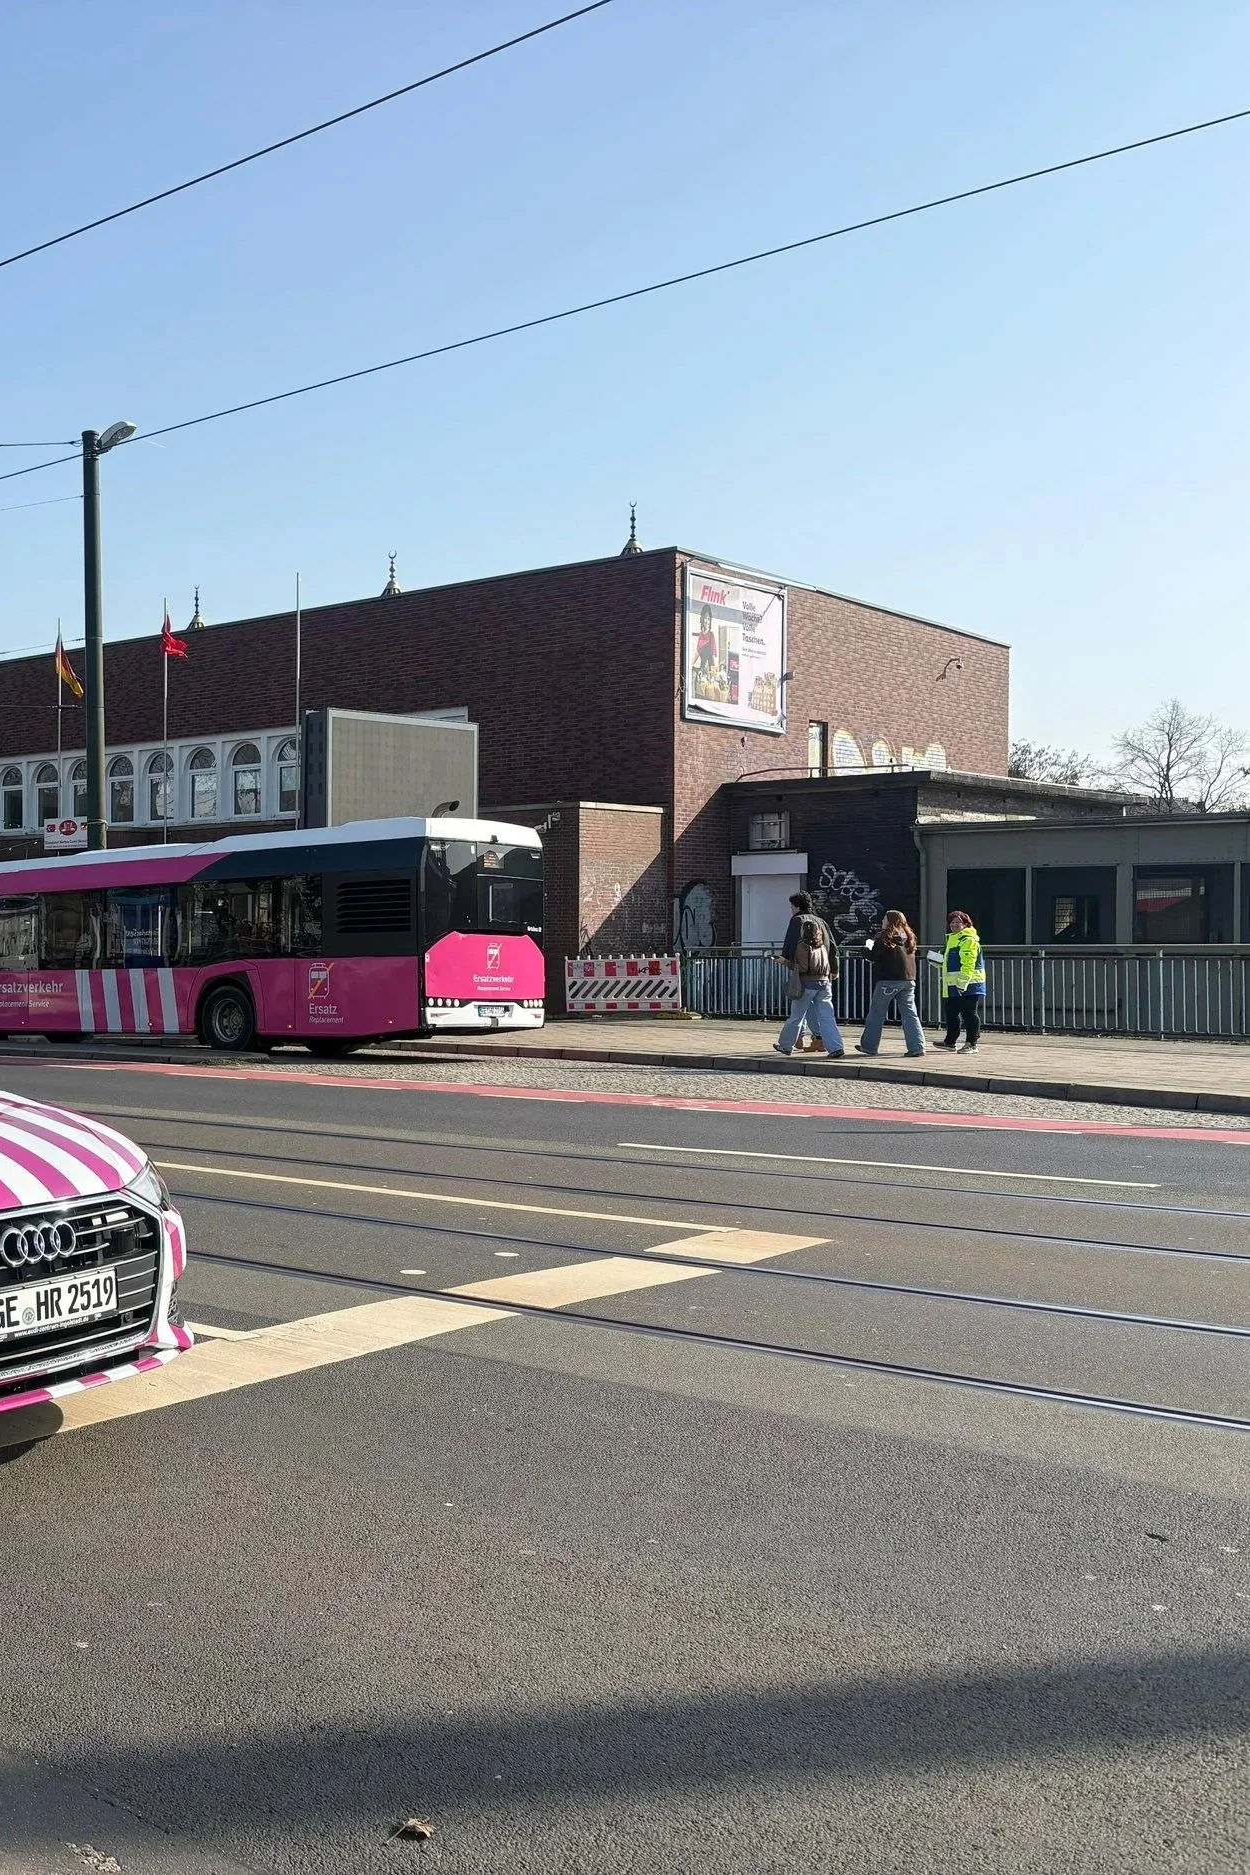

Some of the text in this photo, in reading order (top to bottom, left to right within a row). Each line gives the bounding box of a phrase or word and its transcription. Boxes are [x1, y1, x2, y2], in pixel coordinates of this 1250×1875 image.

[473, 974, 514, 983] Ersatzverkehr
[28, 999, 50, 1008] Service
[309, 1003, 338, 1015] Ersatz
[308, 1016, 344, 1024] Replacement
[36, 1287, 63, 1322] HR
[67, 1275, 114, 1315] 2519
